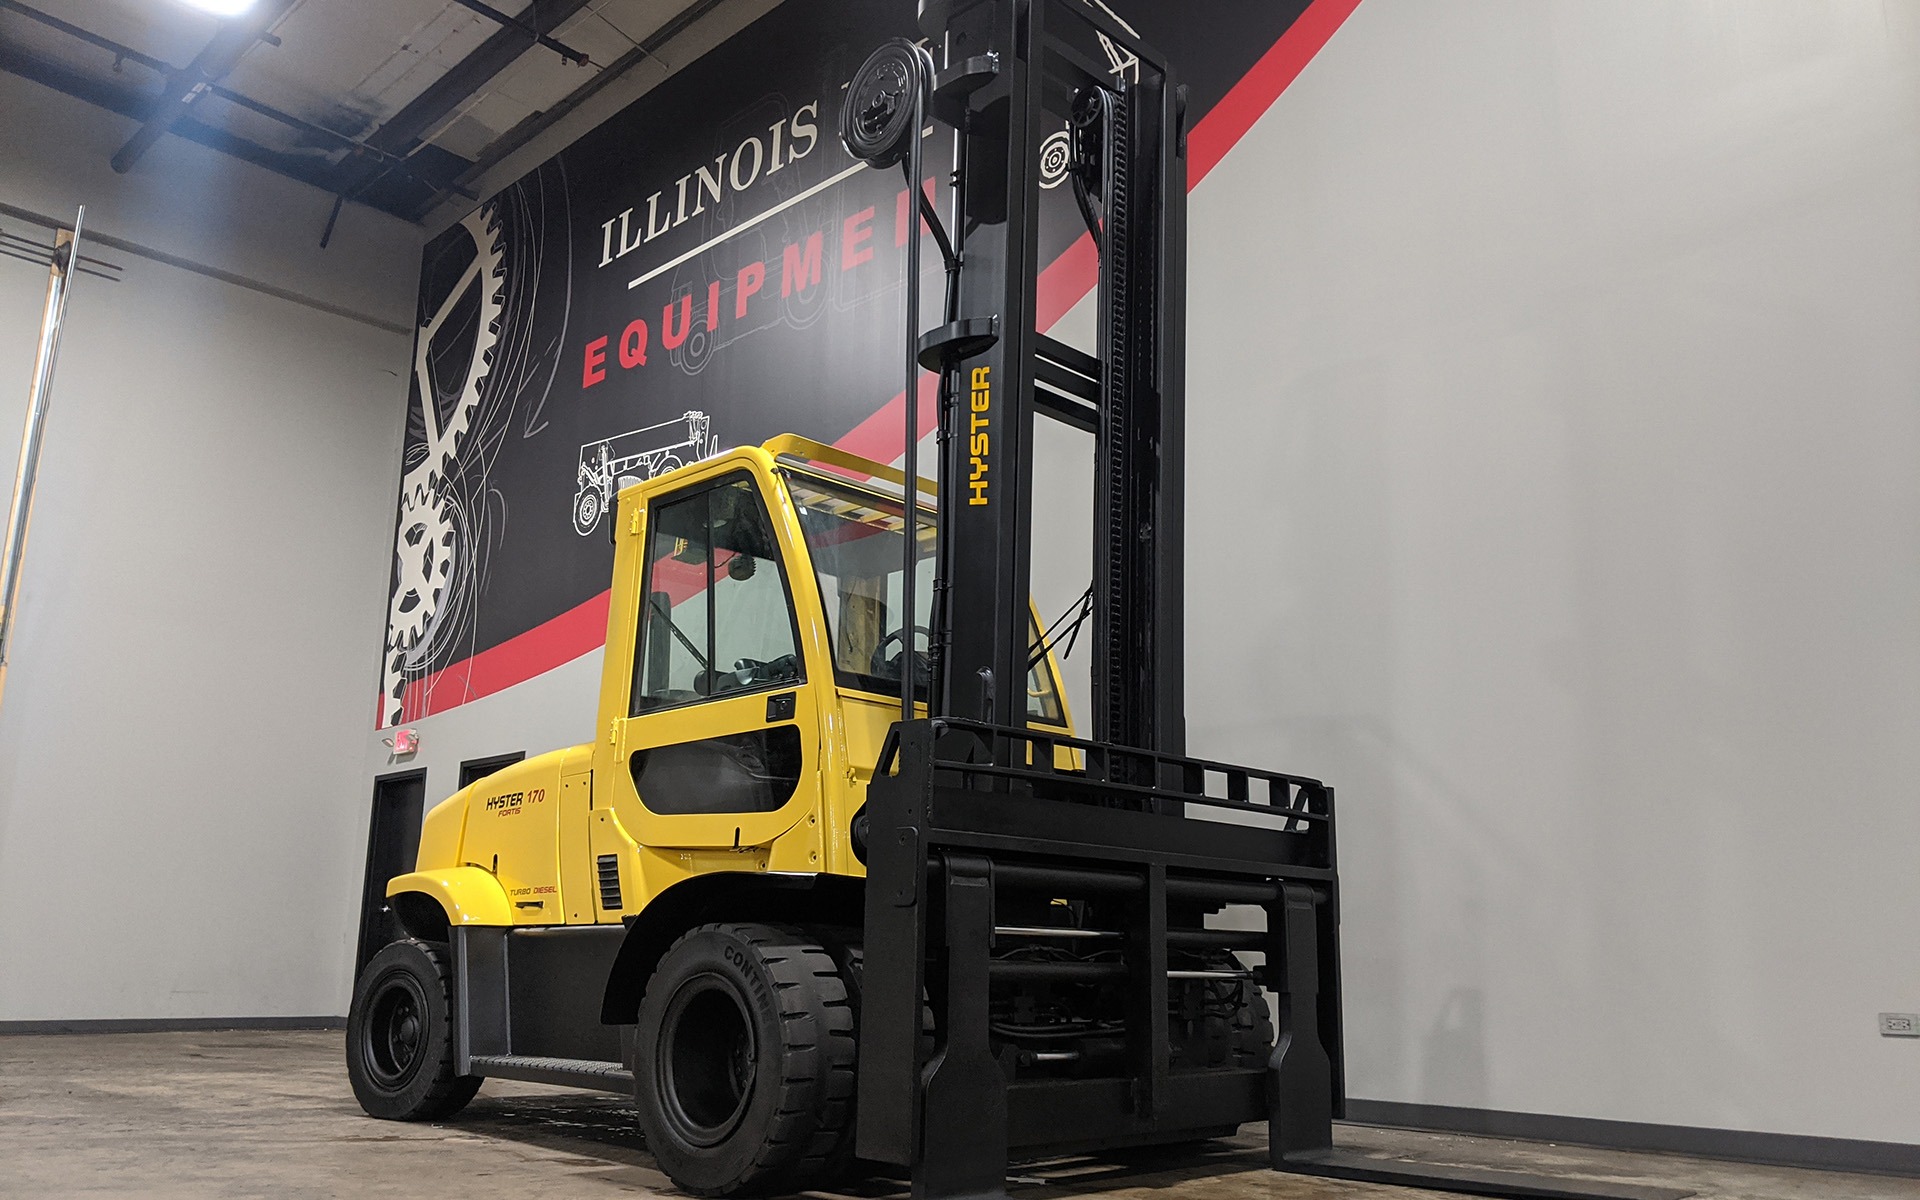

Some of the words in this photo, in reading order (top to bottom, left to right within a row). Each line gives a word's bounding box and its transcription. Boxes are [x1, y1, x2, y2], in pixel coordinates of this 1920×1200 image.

[598, 100, 819, 269] ILLINOIS
[969, 366, 990, 506] HYSTER
[486, 792, 523, 810] HYSTER
[527, 789, 545, 803] 170
[498, 807, 522, 817] FORTIS
[510, 888, 531, 896] TURBO
[533, 886, 557, 894] DIESEL
